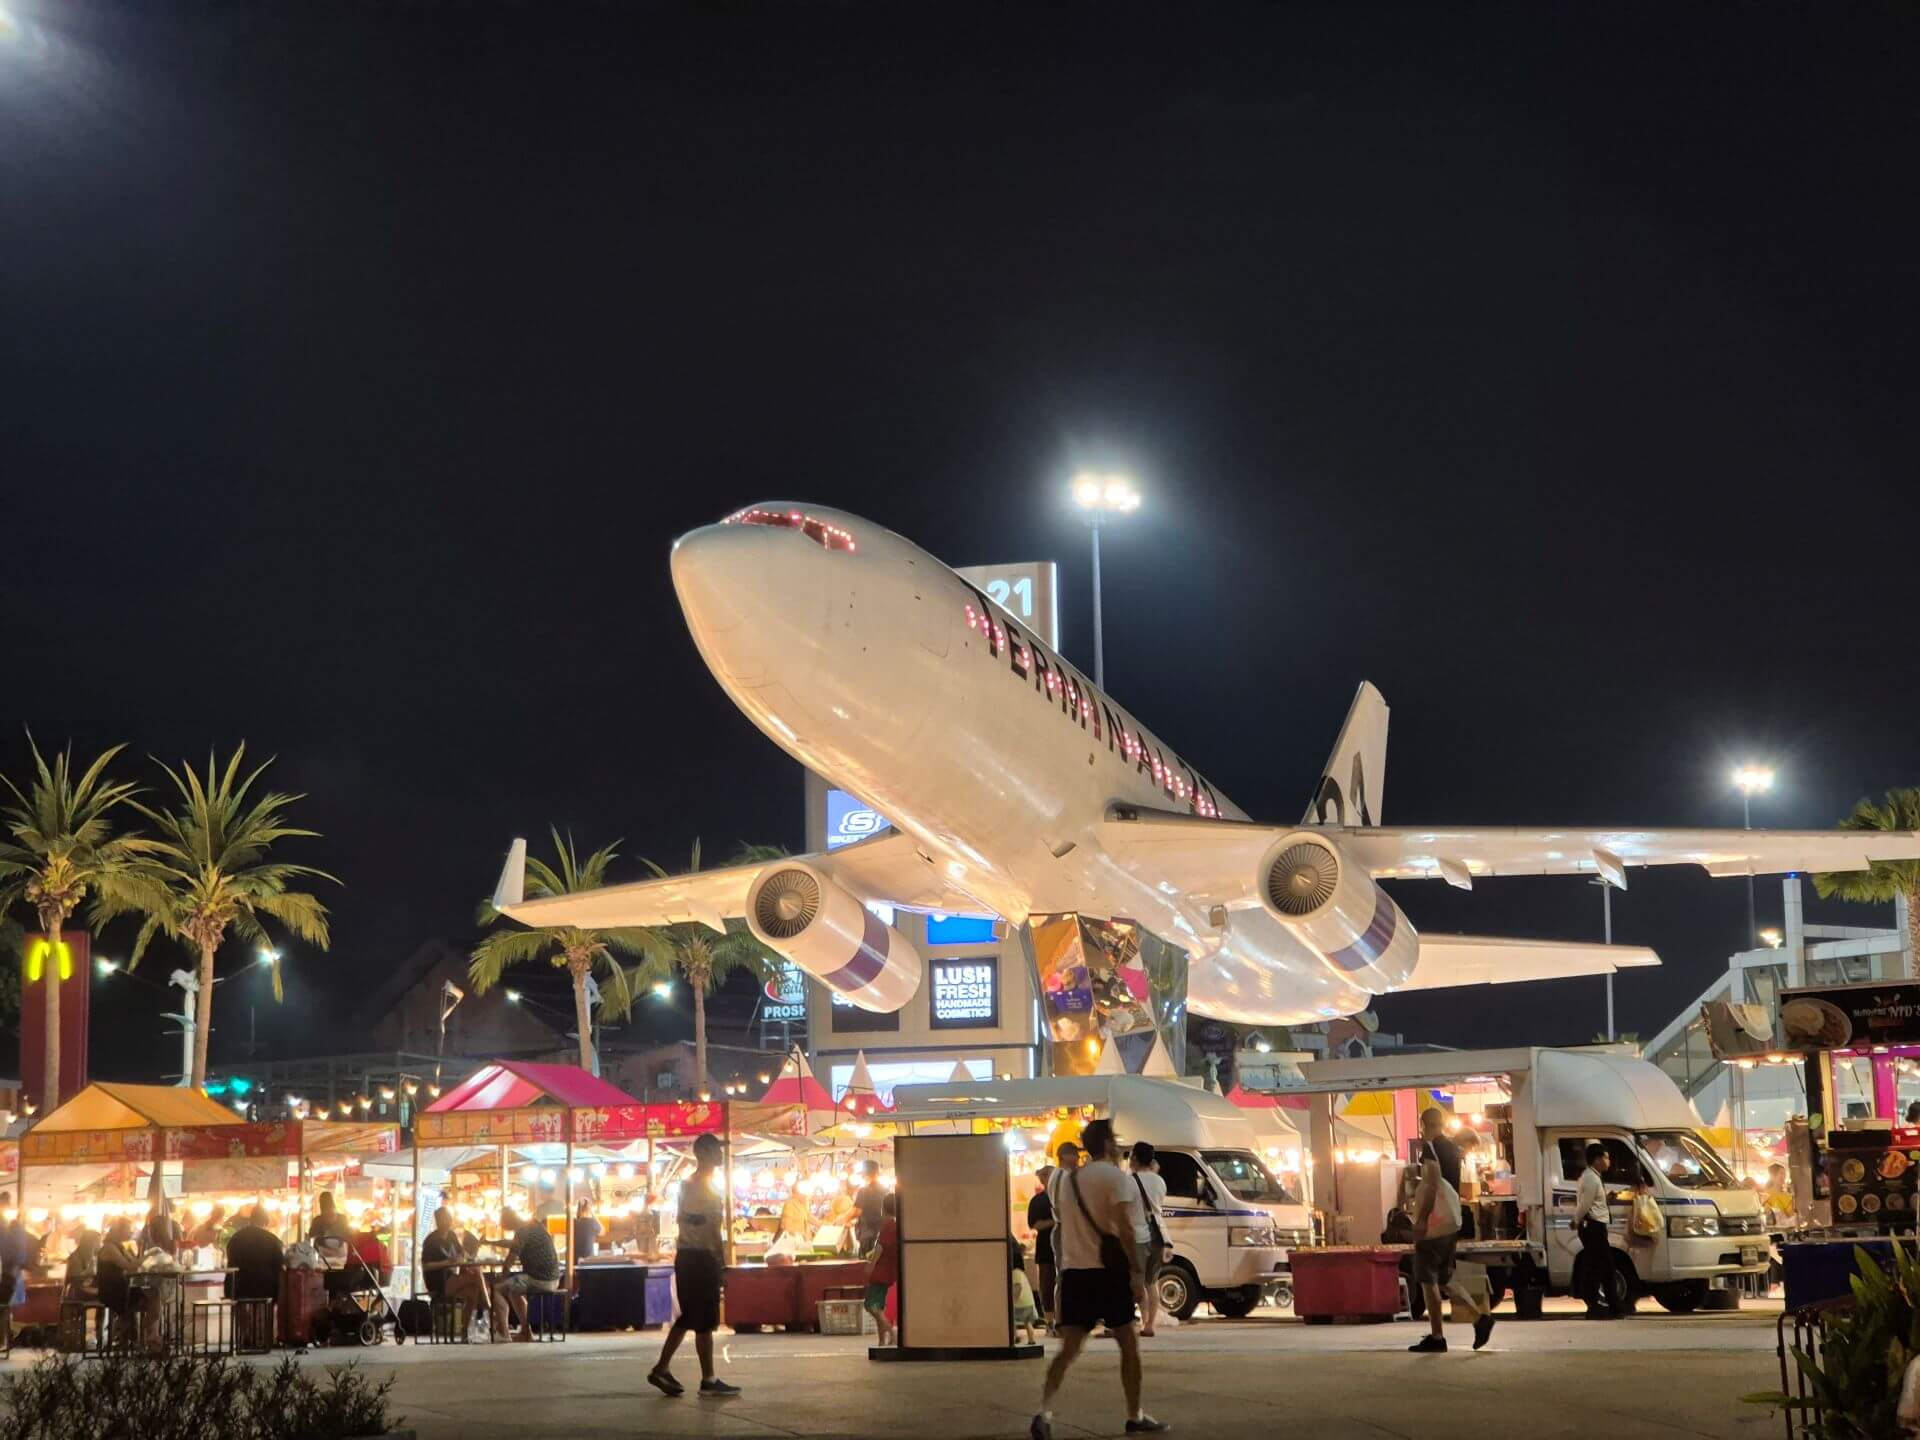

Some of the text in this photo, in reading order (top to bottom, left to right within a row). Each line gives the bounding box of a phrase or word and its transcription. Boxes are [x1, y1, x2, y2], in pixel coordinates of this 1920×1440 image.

[986, 578, 1032, 617] 21
[960, 578, 1175, 801] TERMINAL
[935, 966, 991, 984] LUSH
[936, 984, 991, 999] FRESH
[937, 999, 991, 1008] HANDMADE
